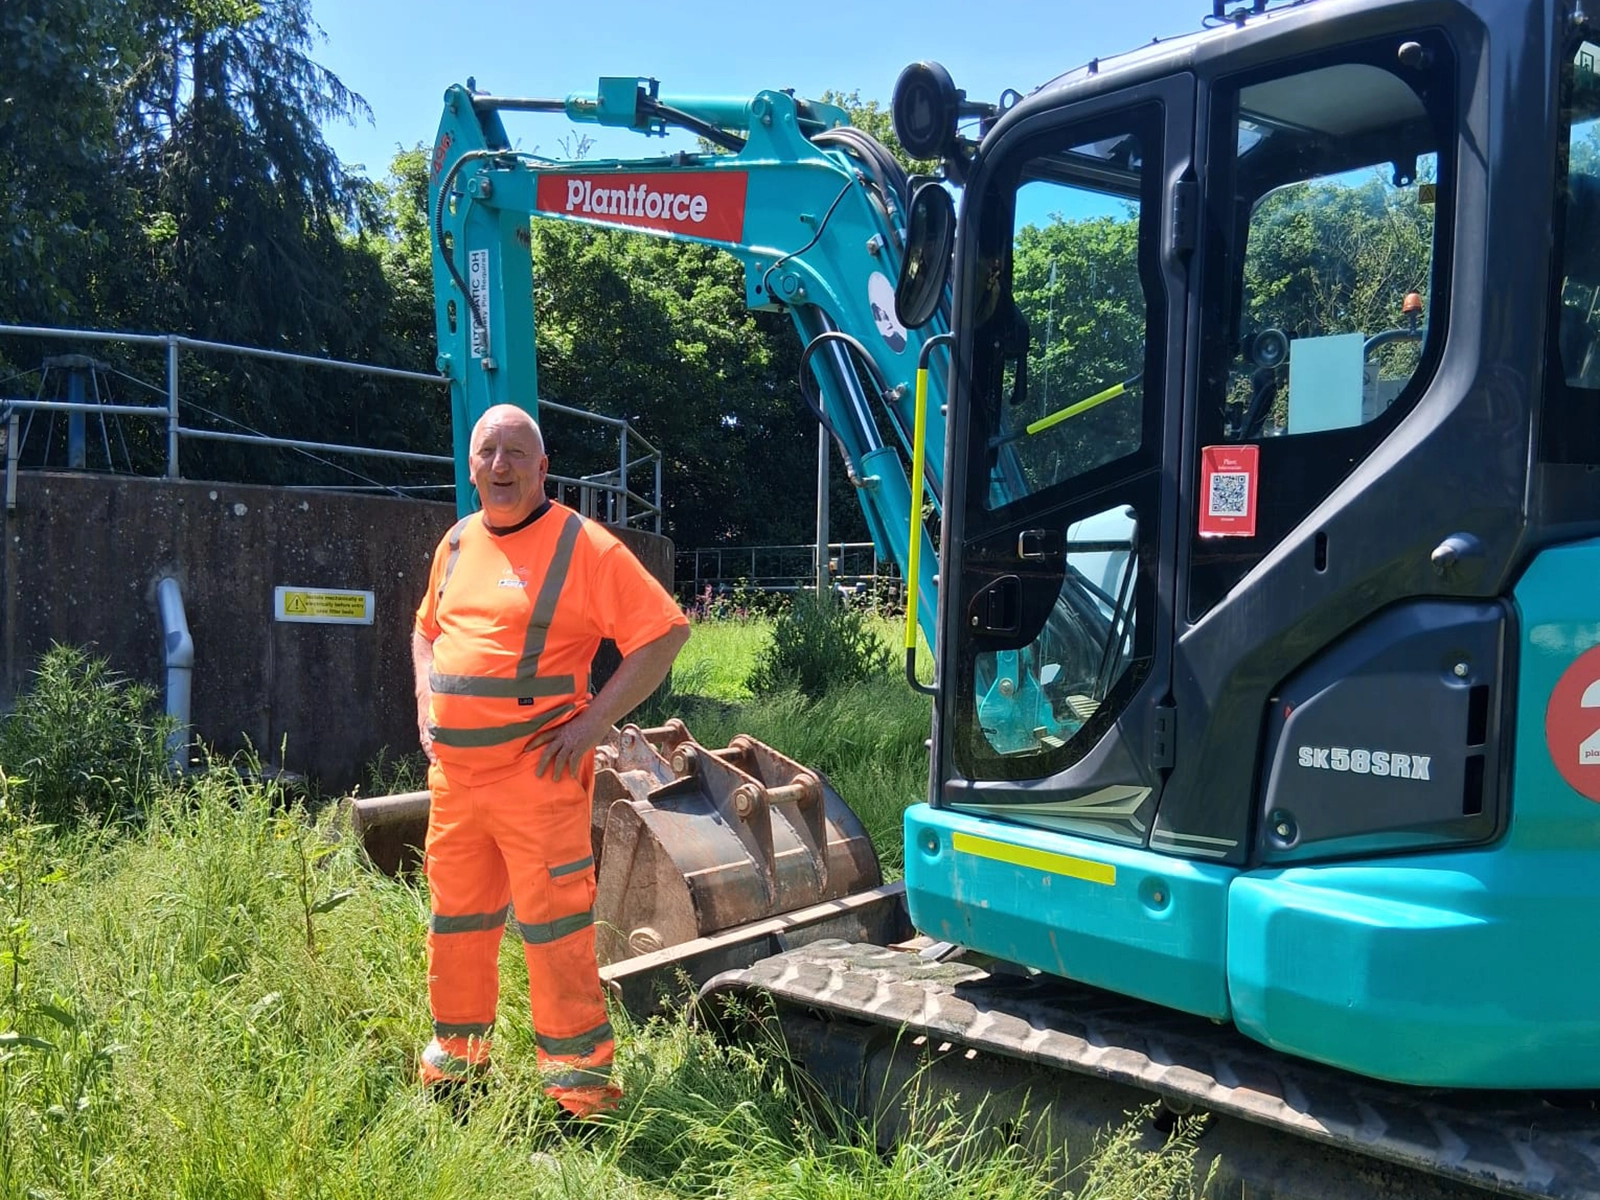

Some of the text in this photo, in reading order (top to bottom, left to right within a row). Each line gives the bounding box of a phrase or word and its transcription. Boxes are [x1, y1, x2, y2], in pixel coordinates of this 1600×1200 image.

[566, 179, 708, 222] Plantforce
[471, 252, 481, 355] AUTOATIC QH
[1298, 746, 1431, 780] SK58SRX
